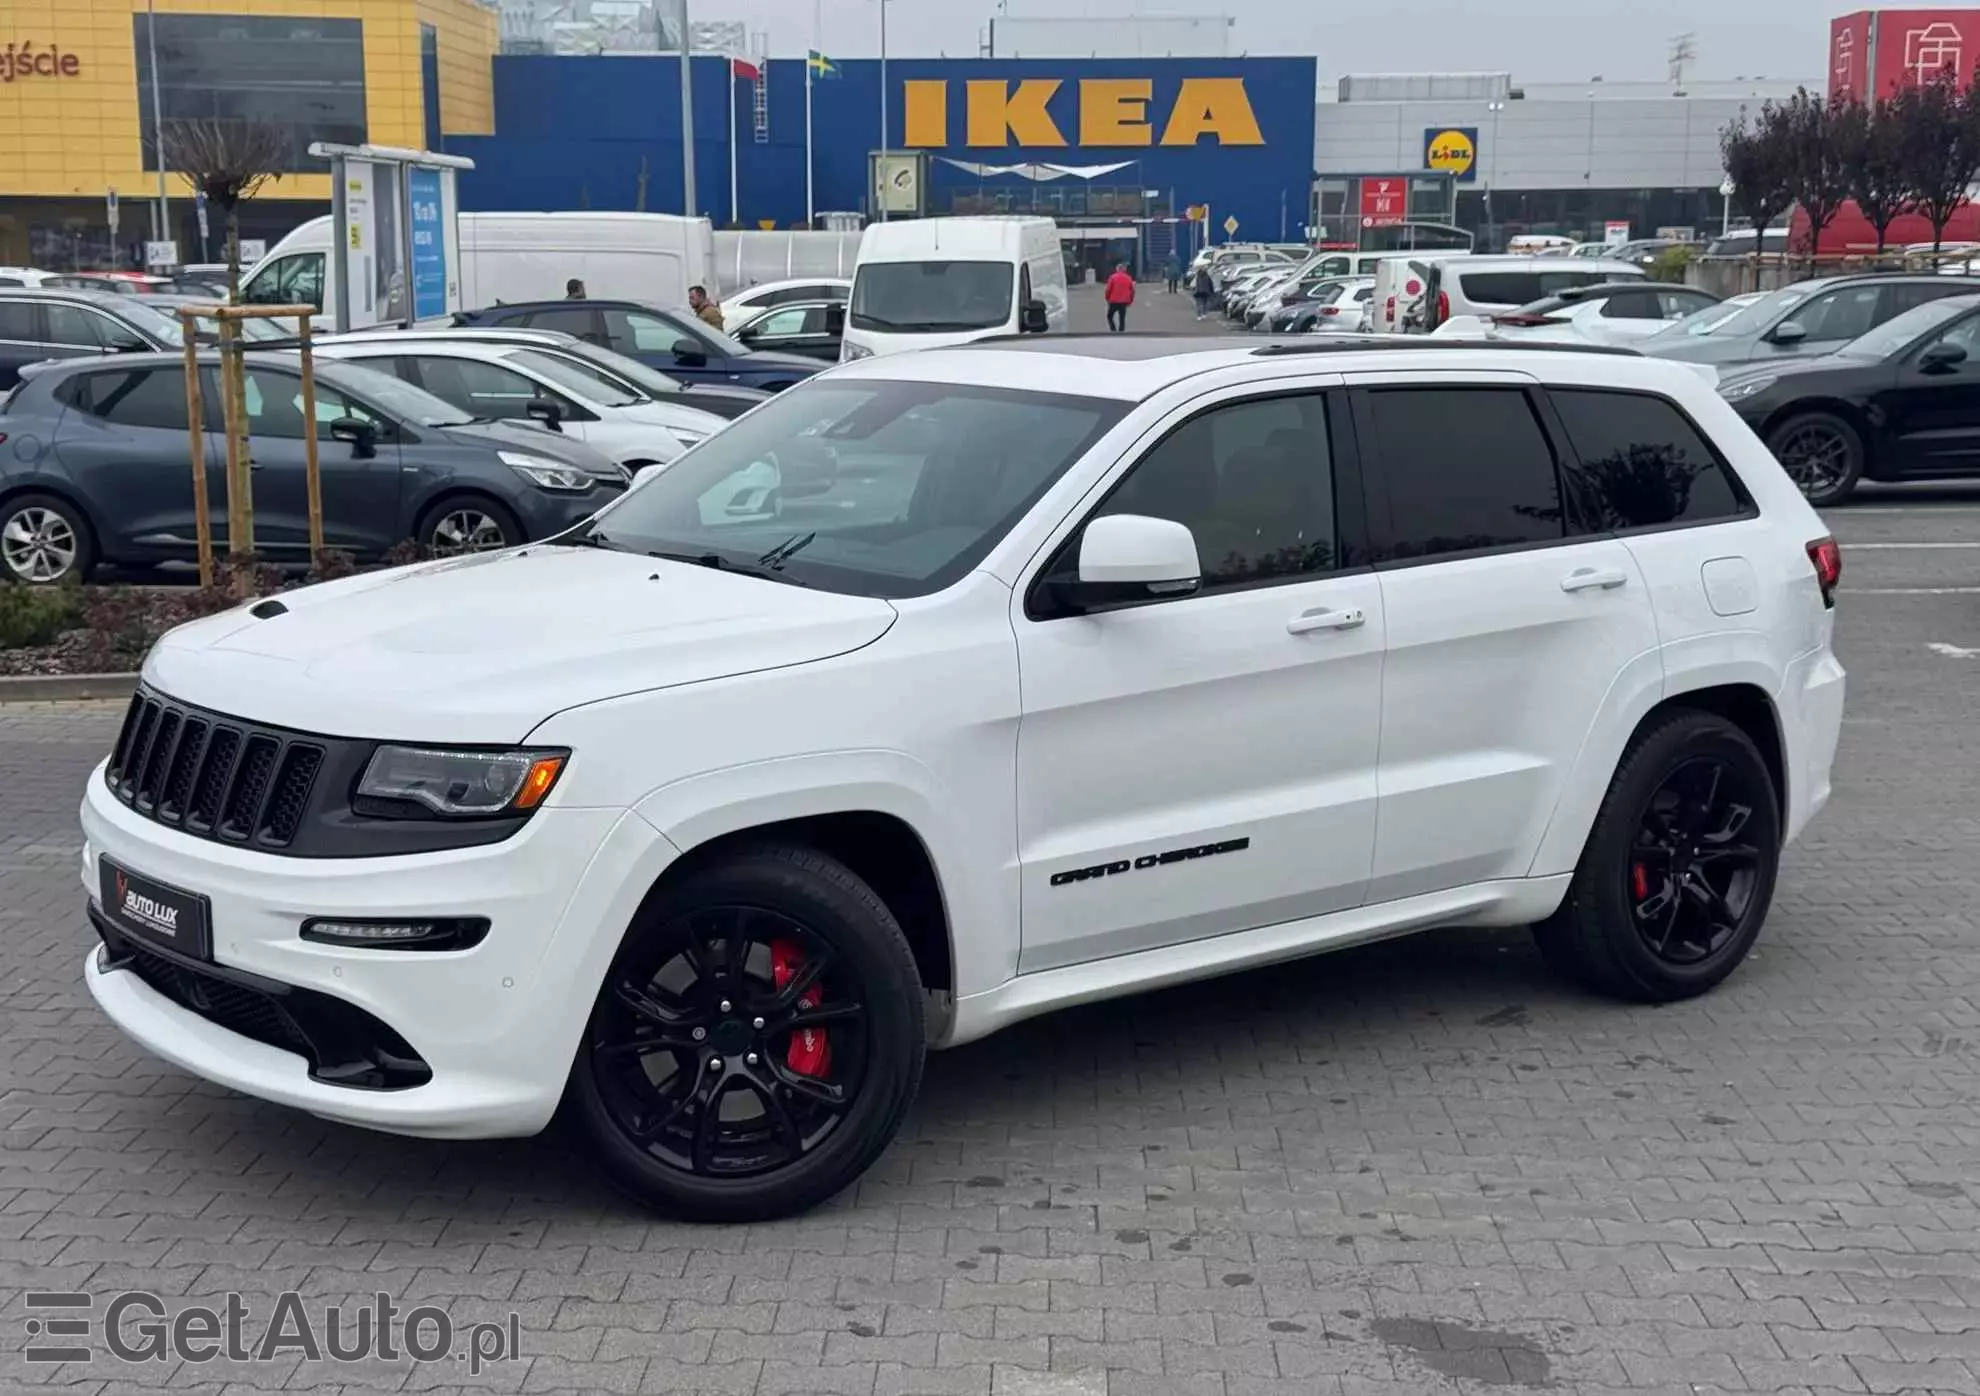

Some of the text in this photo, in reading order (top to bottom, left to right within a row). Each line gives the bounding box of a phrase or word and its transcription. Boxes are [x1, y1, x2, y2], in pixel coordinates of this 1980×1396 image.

[0, 40, 80, 82] jście
[904, 78, 1266, 147] IKEA
[1050, 837, 1250, 886] GRAND CHEROKEE
[154, 902, 178, 925] LUX
